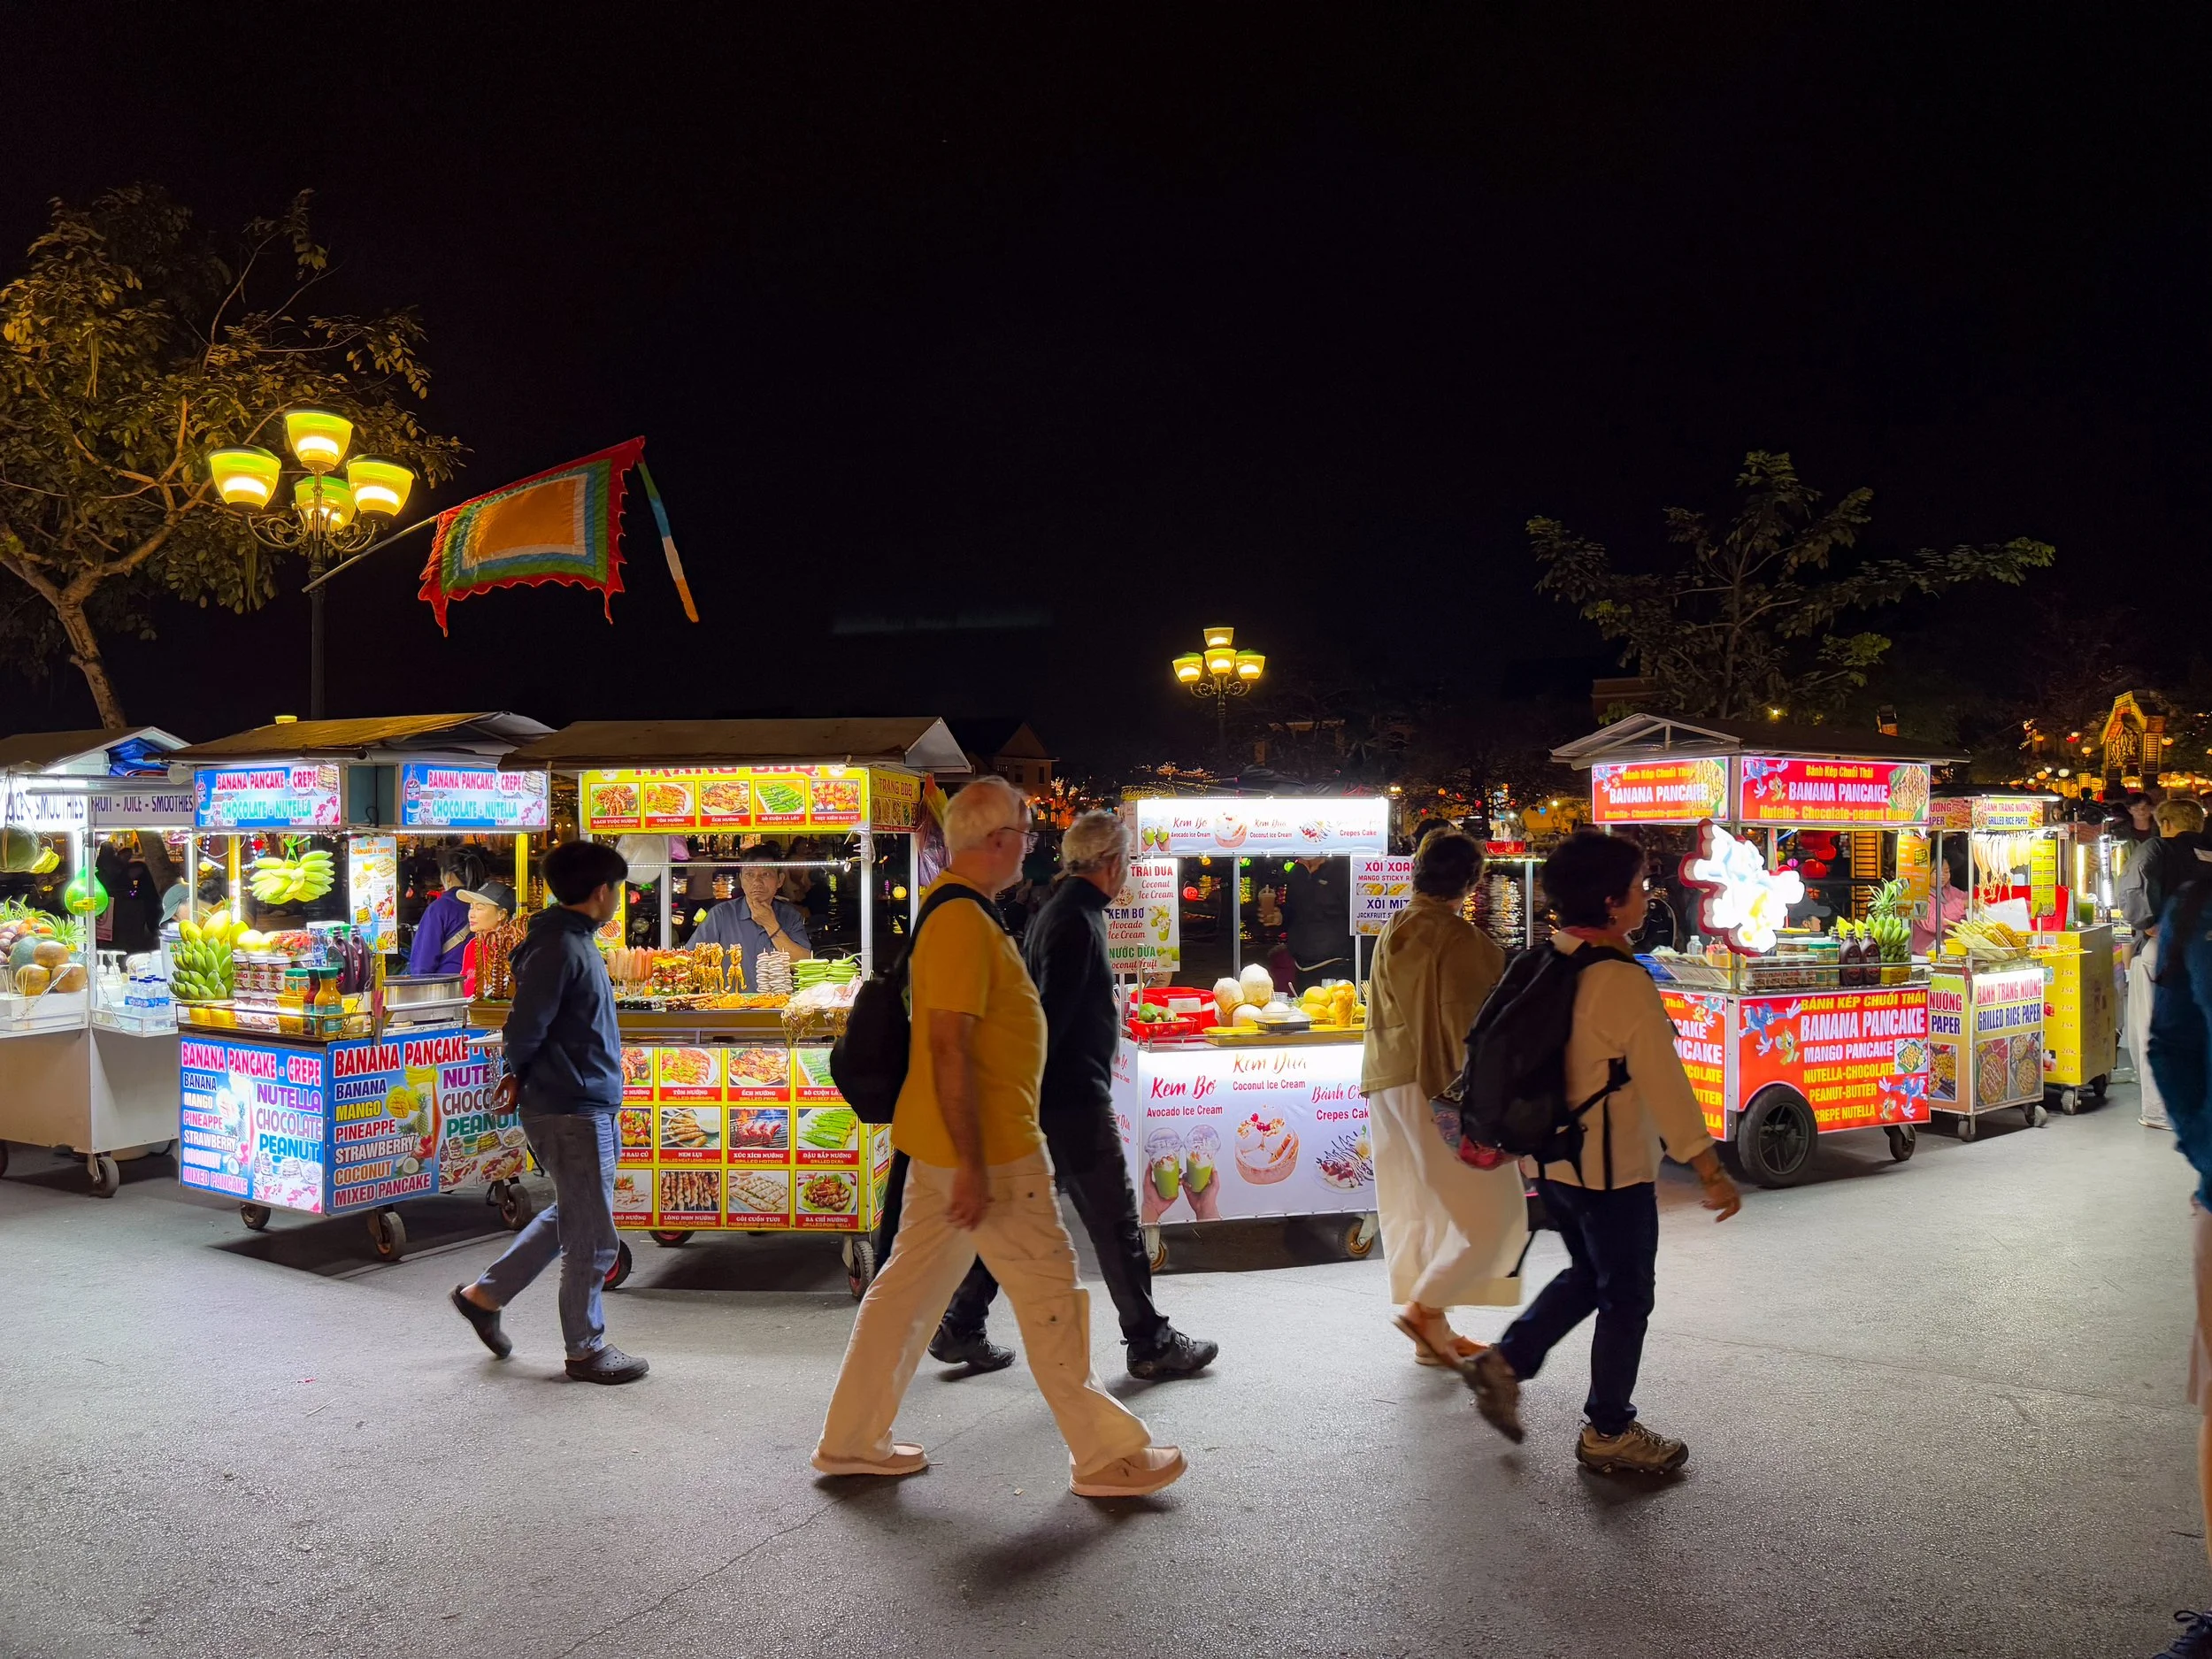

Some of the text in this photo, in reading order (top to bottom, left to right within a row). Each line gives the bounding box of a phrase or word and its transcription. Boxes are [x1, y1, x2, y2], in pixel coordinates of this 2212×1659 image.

[218, 771, 317, 790] BANANA PANCAKE CREPE
[428, 772, 521, 791] BANANA PANCAKE CREPE
[1609, 786, 1654, 804] BANANA
[1789, 782, 1887, 803] BANANA PANCAKE
[91, 795, 194, 813] FRUIT JUICE SMOOTHIES
[221, 799, 312, 818] CHOCOLATE NUTELLA
[433, 800, 518, 818] CHOCOLATE NUTELLA
[2015, 816, 2028, 825] PAPER
[1365, 860, 1383, 872] XÔI
[1141, 879, 1170, 888] Coconut
[1138, 890, 1175, 900] Ice Cream
[1366, 897, 1386, 909] XÔI
[1109, 908, 1129, 919] KEM
[1108, 930, 1146, 940] Ice Cream
[1110, 920, 1143, 930] Avocado
[1112, 960, 1137, 970] oconut
[1801, 997, 1834, 1010] BÁNH
[1901, 991, 1926, 1004] THÁI
[1801, 1008, 1925, 1042] BANANA PANCAKE
[1932, 1015, 1961, 1035] PAPER
[1978, 1002, 2041, 1032] GRILLED RICE PAPER
[334, 1036, 469, 1077] BANANA PANCAKE
[1673, 1037, 1723, 1064] NCAKE
[1804, 1041, 1893, 1064] MANGO PANCAKE
[182, 1042, 321, 1086] BANANA PANCAKE CREPE
[1803, 1062, 1895, 1084] NUTELLA-CHOCOLATE
[184, 1074, 217, 1091] BANANA
[443, 1064, 492, 1089] NUTE
[1233, 1079, 1306, 1091] Coconut Ice Cream
[336, 1079, 387, 1100] BANANA
[1150, 1076, 1187, 1099] Kem
[1310, 1082, 1344, 1104] Bánh
[1809, 1082, 1878, 1102] PEANUT-BUTTER
[184, 1093, 213, 1110] MANGO
[257, 1083, 321, 1113] NUTELLA
[442, 1087, 495, 1117] CHOCO
[184, 1110, 223, 1130] PINEAPPE
[335, 1101, 381, 1122] MANGO
[1147, 1104, 1223, 1118] Avocado Ice Cream
[1317, 1108, 1370, 1123] Crepes Cak
[1815, 1104, 1876, 1123] CREPE NUTELLA
[257, 1108, 322, 1140] CHOCOLATE
[335, 1119, 396, 1142] PINEAPPE
[184, 1132, 236, 1152] STRAWBERRY
[259, 1133, 319, 1162] PEANUT
[335, 1136, 416, 1164] STRAWBERRY
[184, 1168, 248, 1194] MIXED PANCAKE
[335, 1161, 392, 1185] COCONUT
[335, 1174, 431, 1207] MIXED PANCAKE
